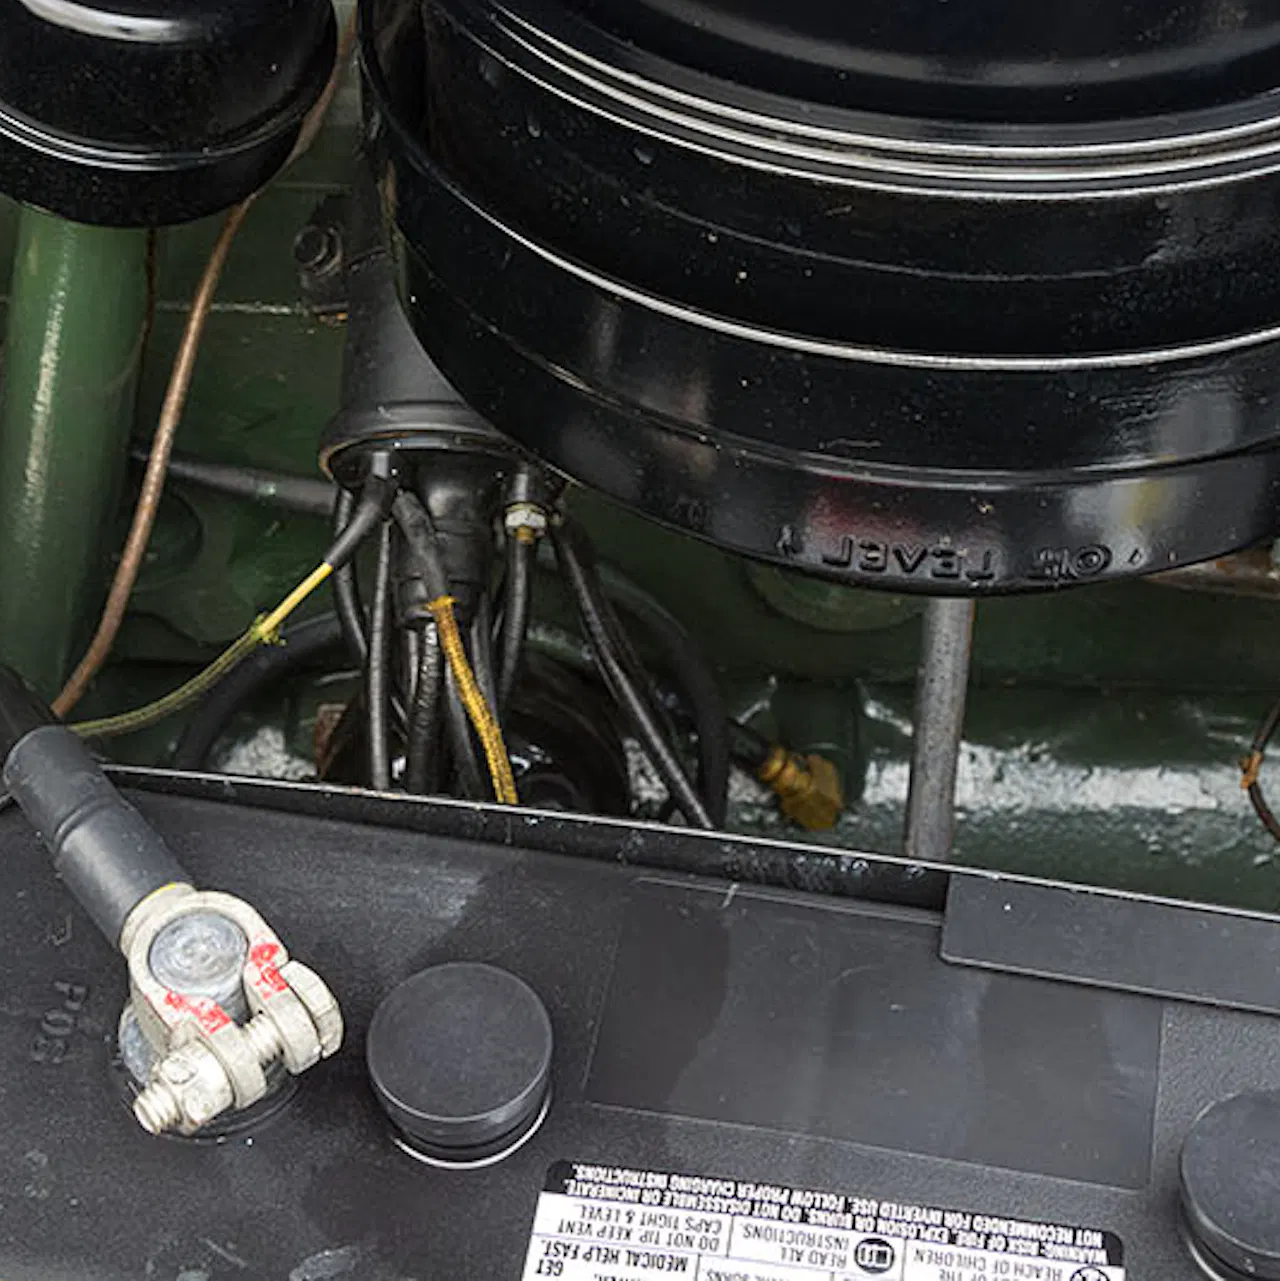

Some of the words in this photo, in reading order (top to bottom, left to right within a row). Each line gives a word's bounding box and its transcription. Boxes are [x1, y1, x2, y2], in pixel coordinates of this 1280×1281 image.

[640, 1189, 661, 1206] OR
[736, 1182, 789, 1205] PROPER
[790, 1190, 846, 1213] FOLLOW
[662, 1190, 751, 1216] DISASSEMBLE
[751, 1202, 779, 1220] NOT
[639, 1211, 680, 1231] TIGHT
[780, 1205, 802, 1222] DO
[558, 1219, 592, 1236] VENT
[686, 1216, 722, 1236] CAPS
[855, 1215, 875, 1233] OR
[876, 1217, 949, 1244] EXPLOSION
[972, 1214, 1074, 1246] RECOMMENDED
[596, 1225, 633, 1242] KEEP
[666, 1233, 696, 1249] NOT
[1075, 1229, 1103, 1249] NOT
[540, 1240, 580, 1261] FAST.
[699, 1236, 720, 1253] DO
[987, 1234, 1007, 1252] OF
[582, 1246, 620, 1265] HELP
[625, 1250, 689, 1273] MEDICAL
[781, 1247, 804, 1263] ALL
[809, 1251, 848, 1270] READ
[535, 1260, 564, 1278] GET
[993, 1260, 1009, 1275] OF
[1014, 1263, 1063, 1280] REACH
